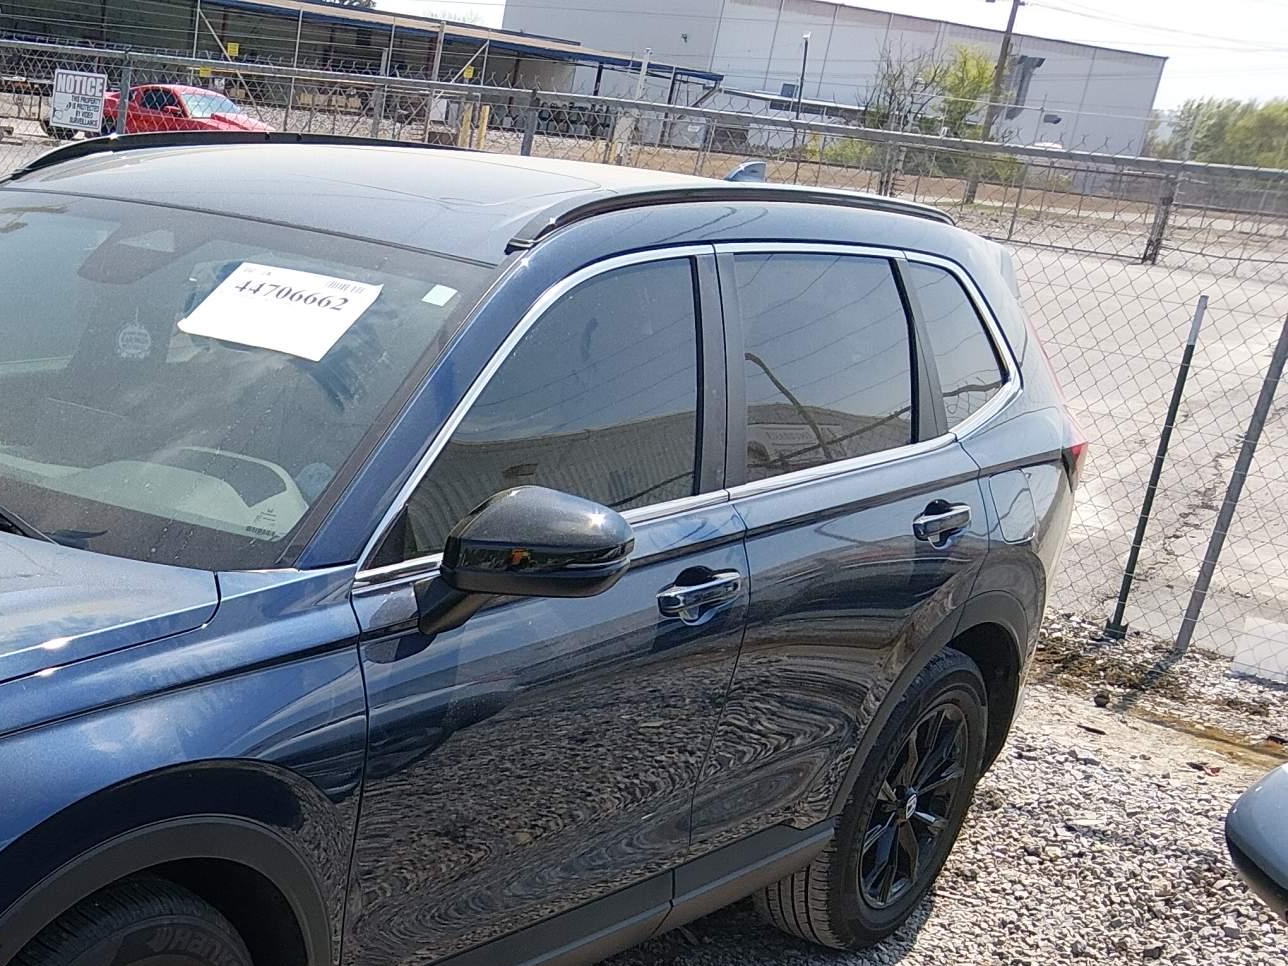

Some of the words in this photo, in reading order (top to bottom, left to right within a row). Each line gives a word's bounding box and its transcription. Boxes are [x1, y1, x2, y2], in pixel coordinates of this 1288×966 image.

[56, 73, 103, 97] NOTICE
[69, 116, 98, 127] SURVEILLANCE
[235, 279, 349, 311] 44706662
